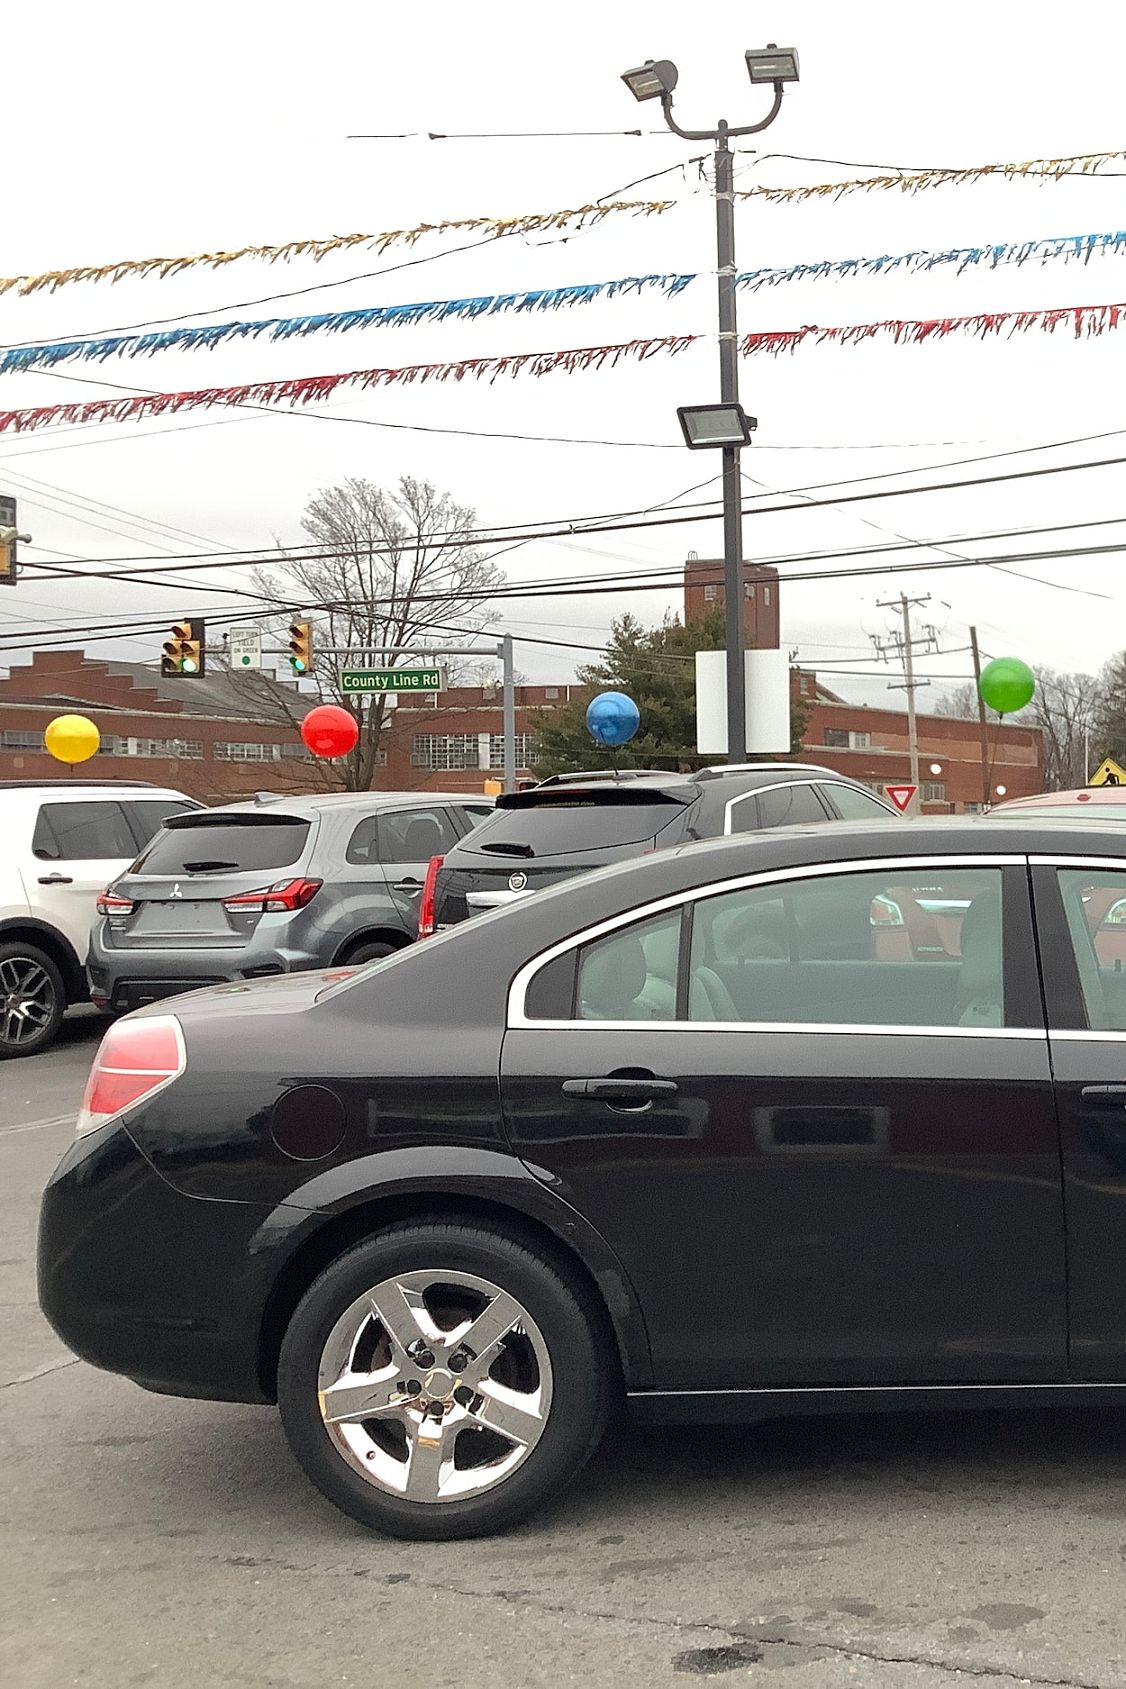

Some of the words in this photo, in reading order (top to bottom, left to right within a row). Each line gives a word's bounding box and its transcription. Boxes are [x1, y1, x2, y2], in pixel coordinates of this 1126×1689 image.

[343, 675, 388, 689] County
[393, 674, 419, 686] Line
[423, 674, 438, 685] Rd
